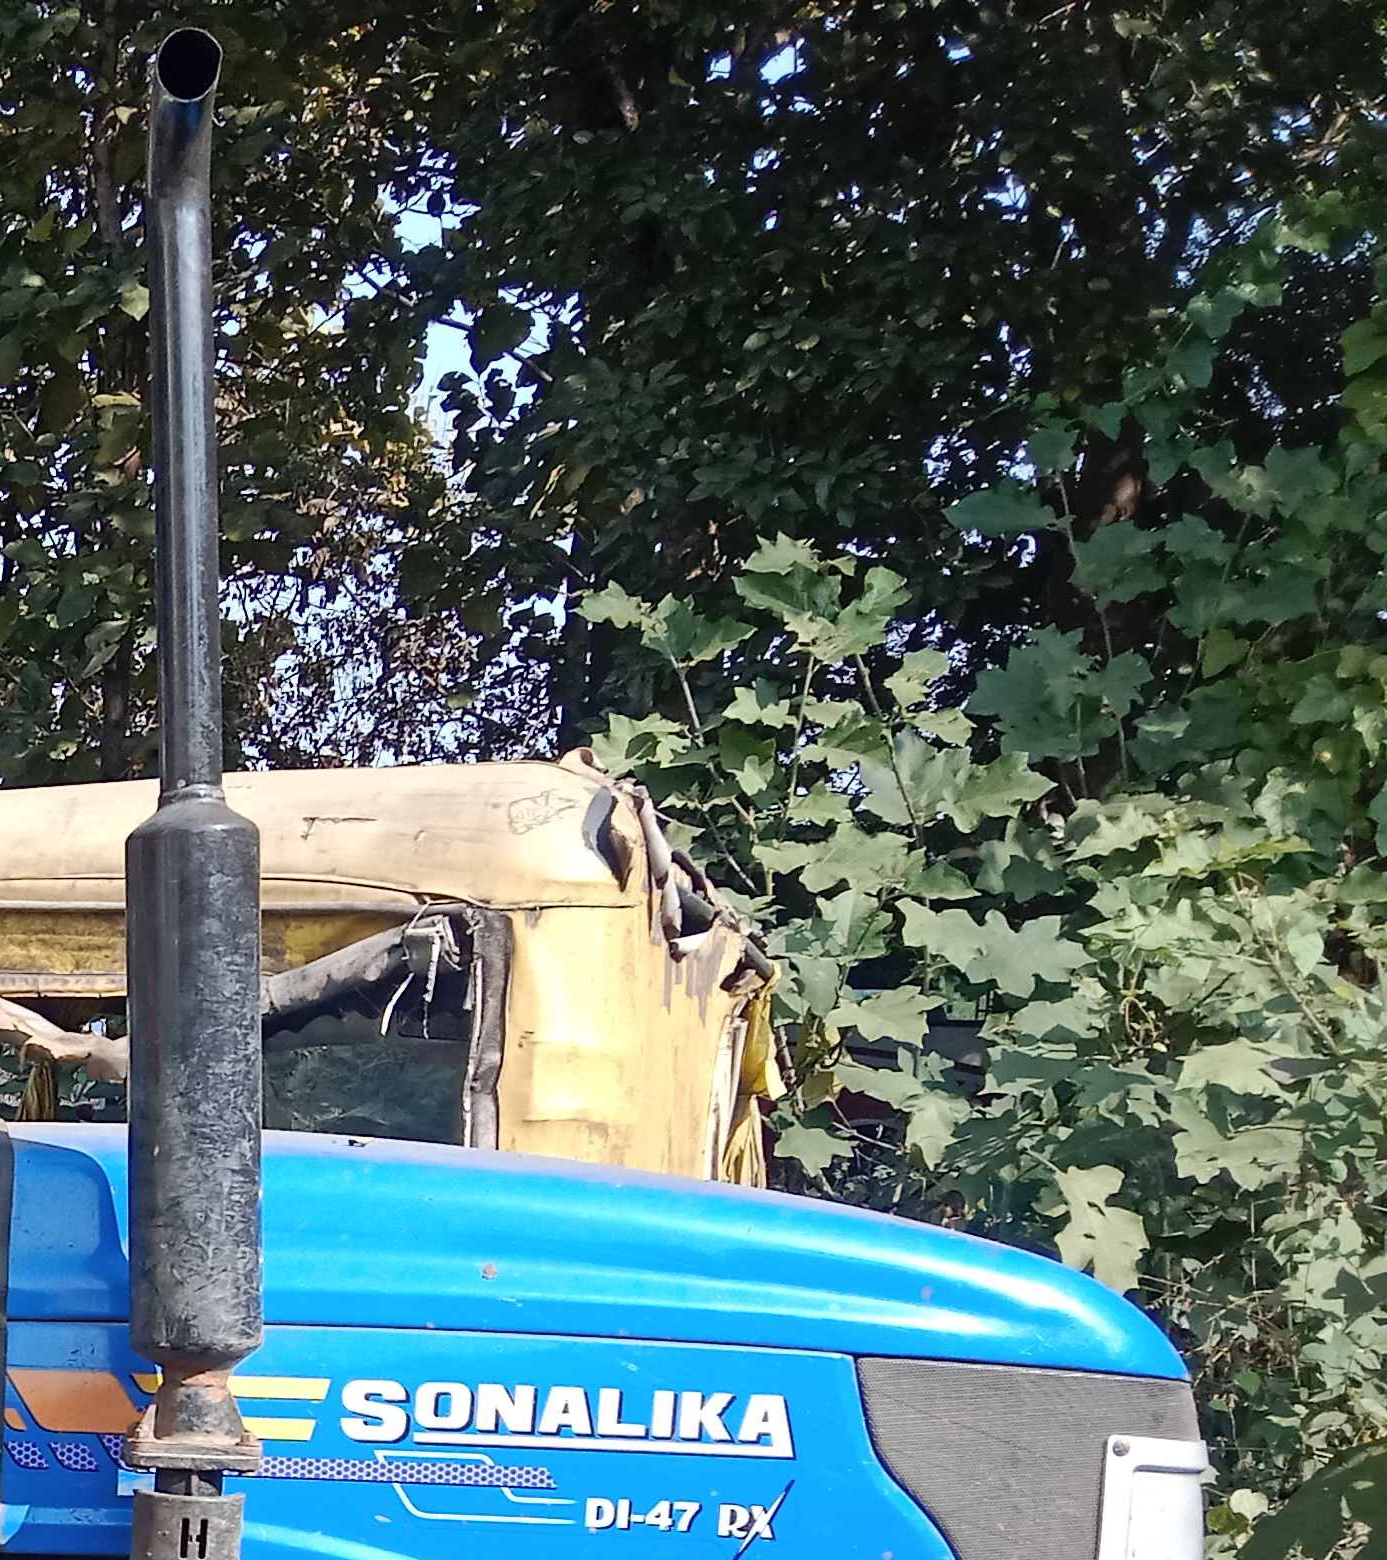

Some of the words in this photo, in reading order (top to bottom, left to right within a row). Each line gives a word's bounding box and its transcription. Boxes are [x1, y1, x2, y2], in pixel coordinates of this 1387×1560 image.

[340, 1378, 795, 1460] SONALIKA
[584, 1497, 703, 1532] DI-47
[717, 1492, 785, 1550] RX
